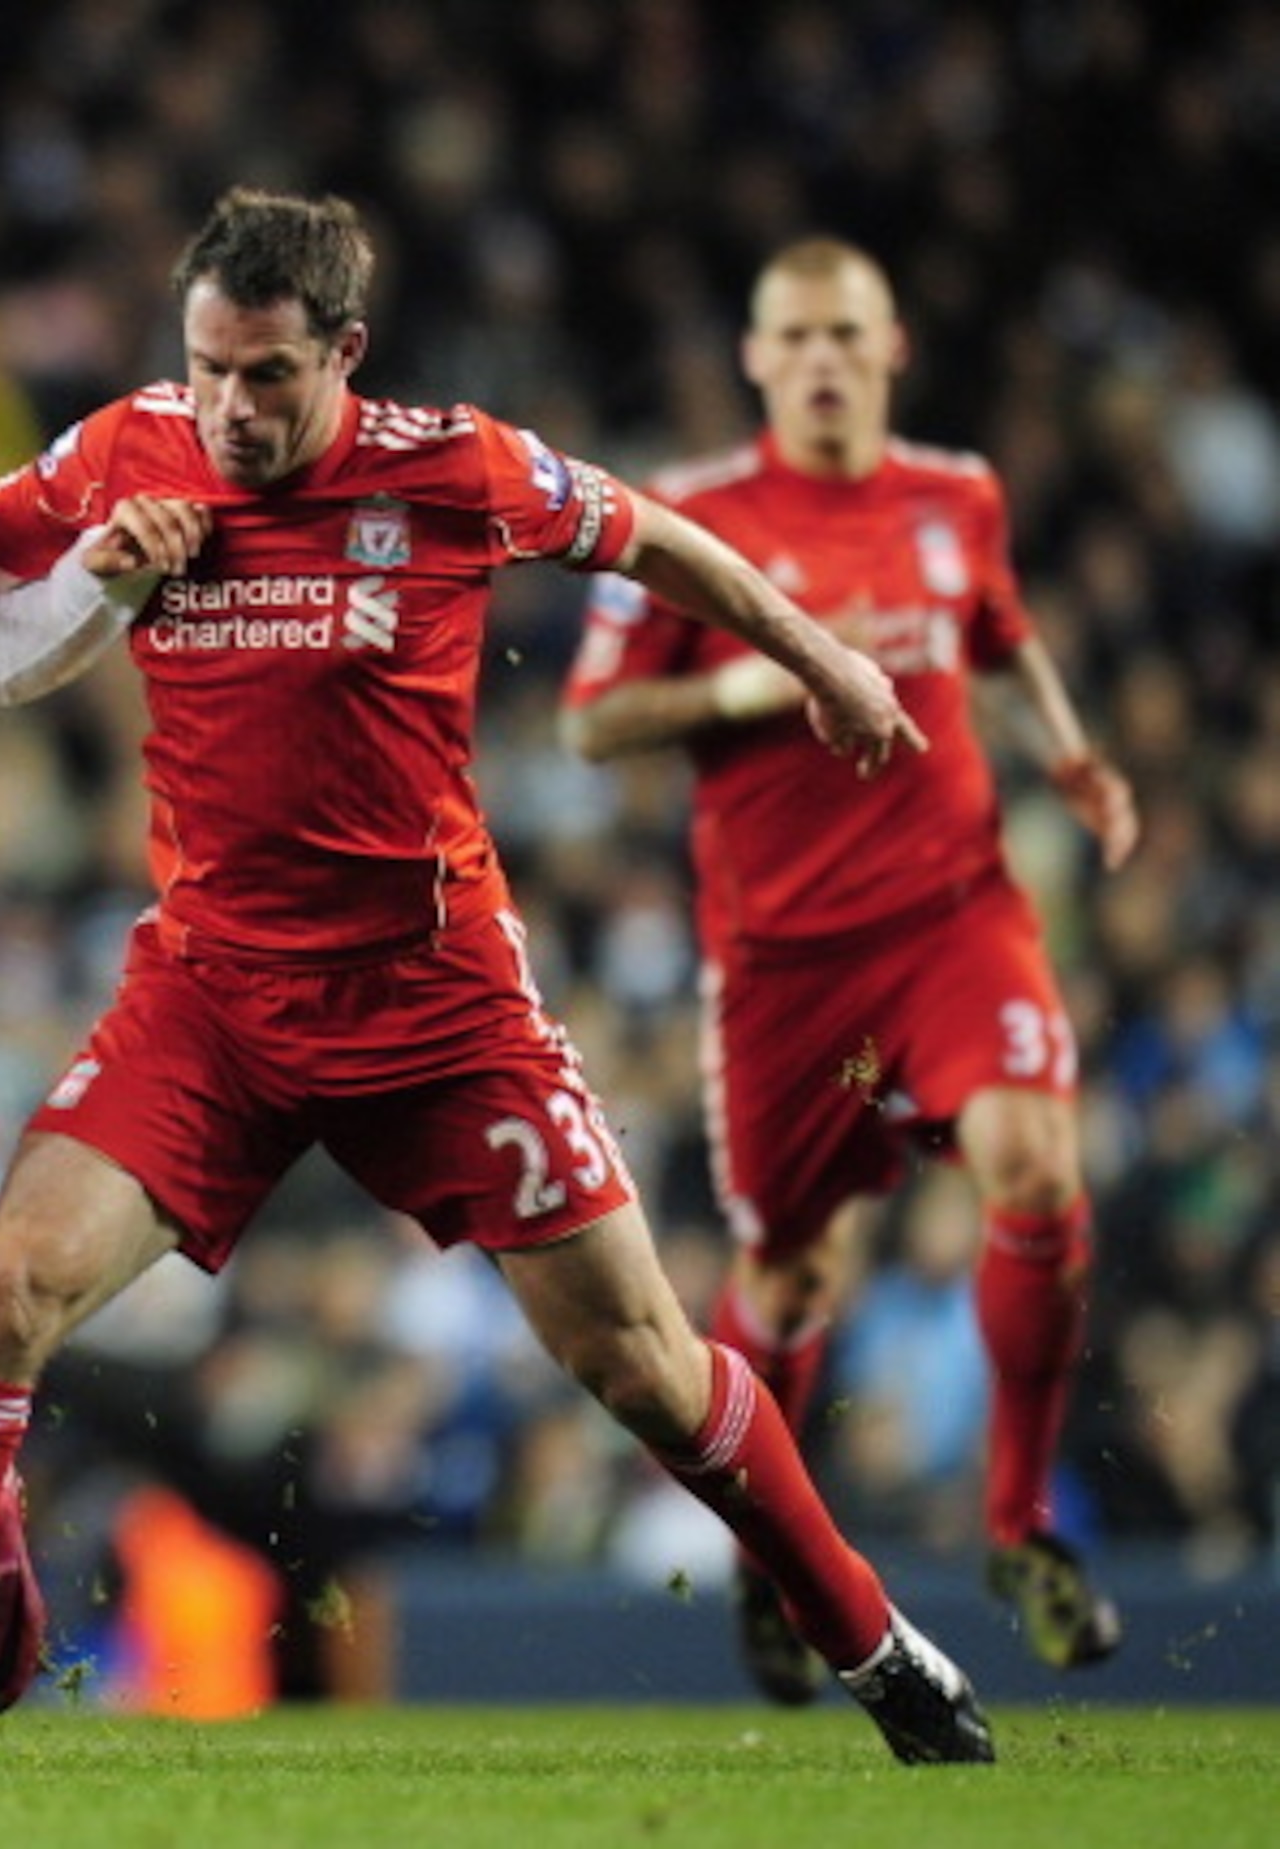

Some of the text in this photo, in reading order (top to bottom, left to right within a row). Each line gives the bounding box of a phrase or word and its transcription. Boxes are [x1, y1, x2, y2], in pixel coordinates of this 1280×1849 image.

[161, 575, 336, 614] Standard
[148, 613, 334, 653] Chartered
[484, 1090, 610, 1218] 23
